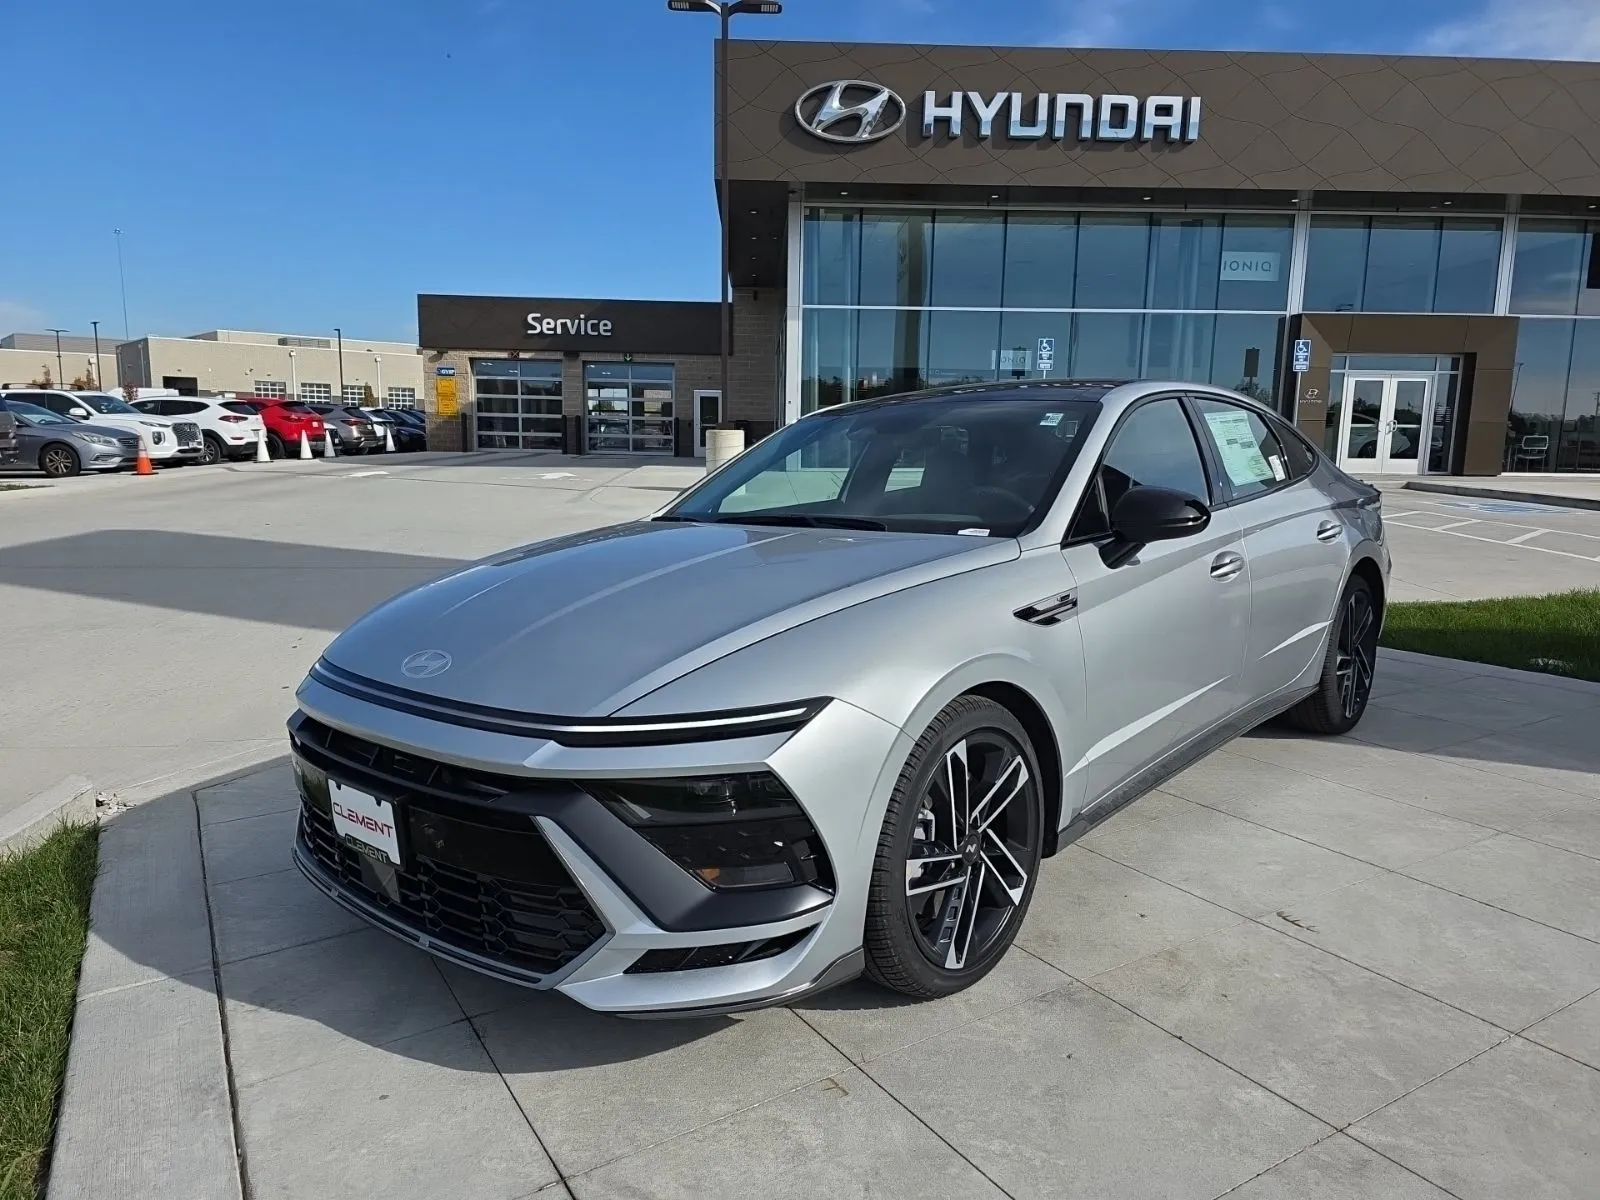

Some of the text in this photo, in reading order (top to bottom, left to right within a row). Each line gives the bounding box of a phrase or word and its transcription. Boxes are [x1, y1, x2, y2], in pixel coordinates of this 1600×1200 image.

[922, 90, 1202, 143] HYUNDAI
[1223, 260, 1272, 272] IONIQ
[526, 313, 612, 336] Service
[333, 802, 394, 838] CLEMENT
[345, 835, 388, 864] CLEMENT
